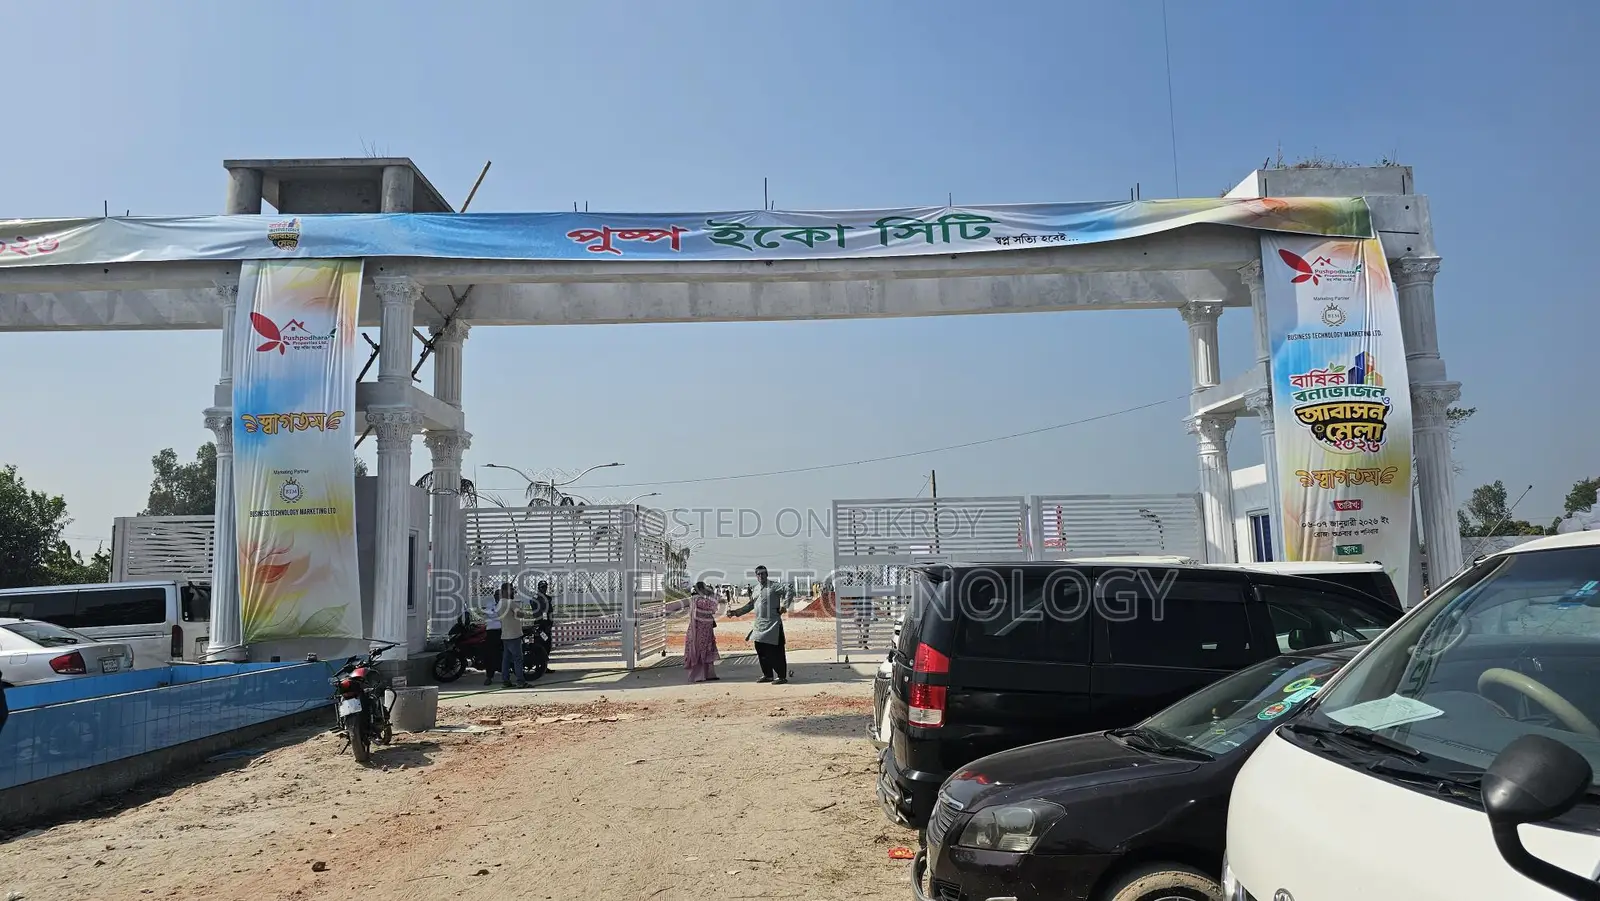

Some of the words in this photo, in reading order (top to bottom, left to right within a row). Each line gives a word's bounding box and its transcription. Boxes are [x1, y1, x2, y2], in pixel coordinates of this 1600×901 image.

[566, 225, 690, 255] পুষ্প
[706, 219, 857, 251] ইকো
[869, 213, 1001, 246] সিটি
[1012, 232, 1037, 244] সত্যি
[1287, 333, 1311, 341] BUSINESS
[1312, 331, 1343, 339] TECHNOLOGY
[1290, 368, 1346, 388] বার্ষিক
[256, 411, 327, 435] স্বাগতম
[1296, 402, 1386, 424] আবাসন
[1326, 421, 1385, 441] মেলা
[1333, 438, 1380, 453] ২০২৬
[1311, 468, 1381, 489] স্বাগতম
